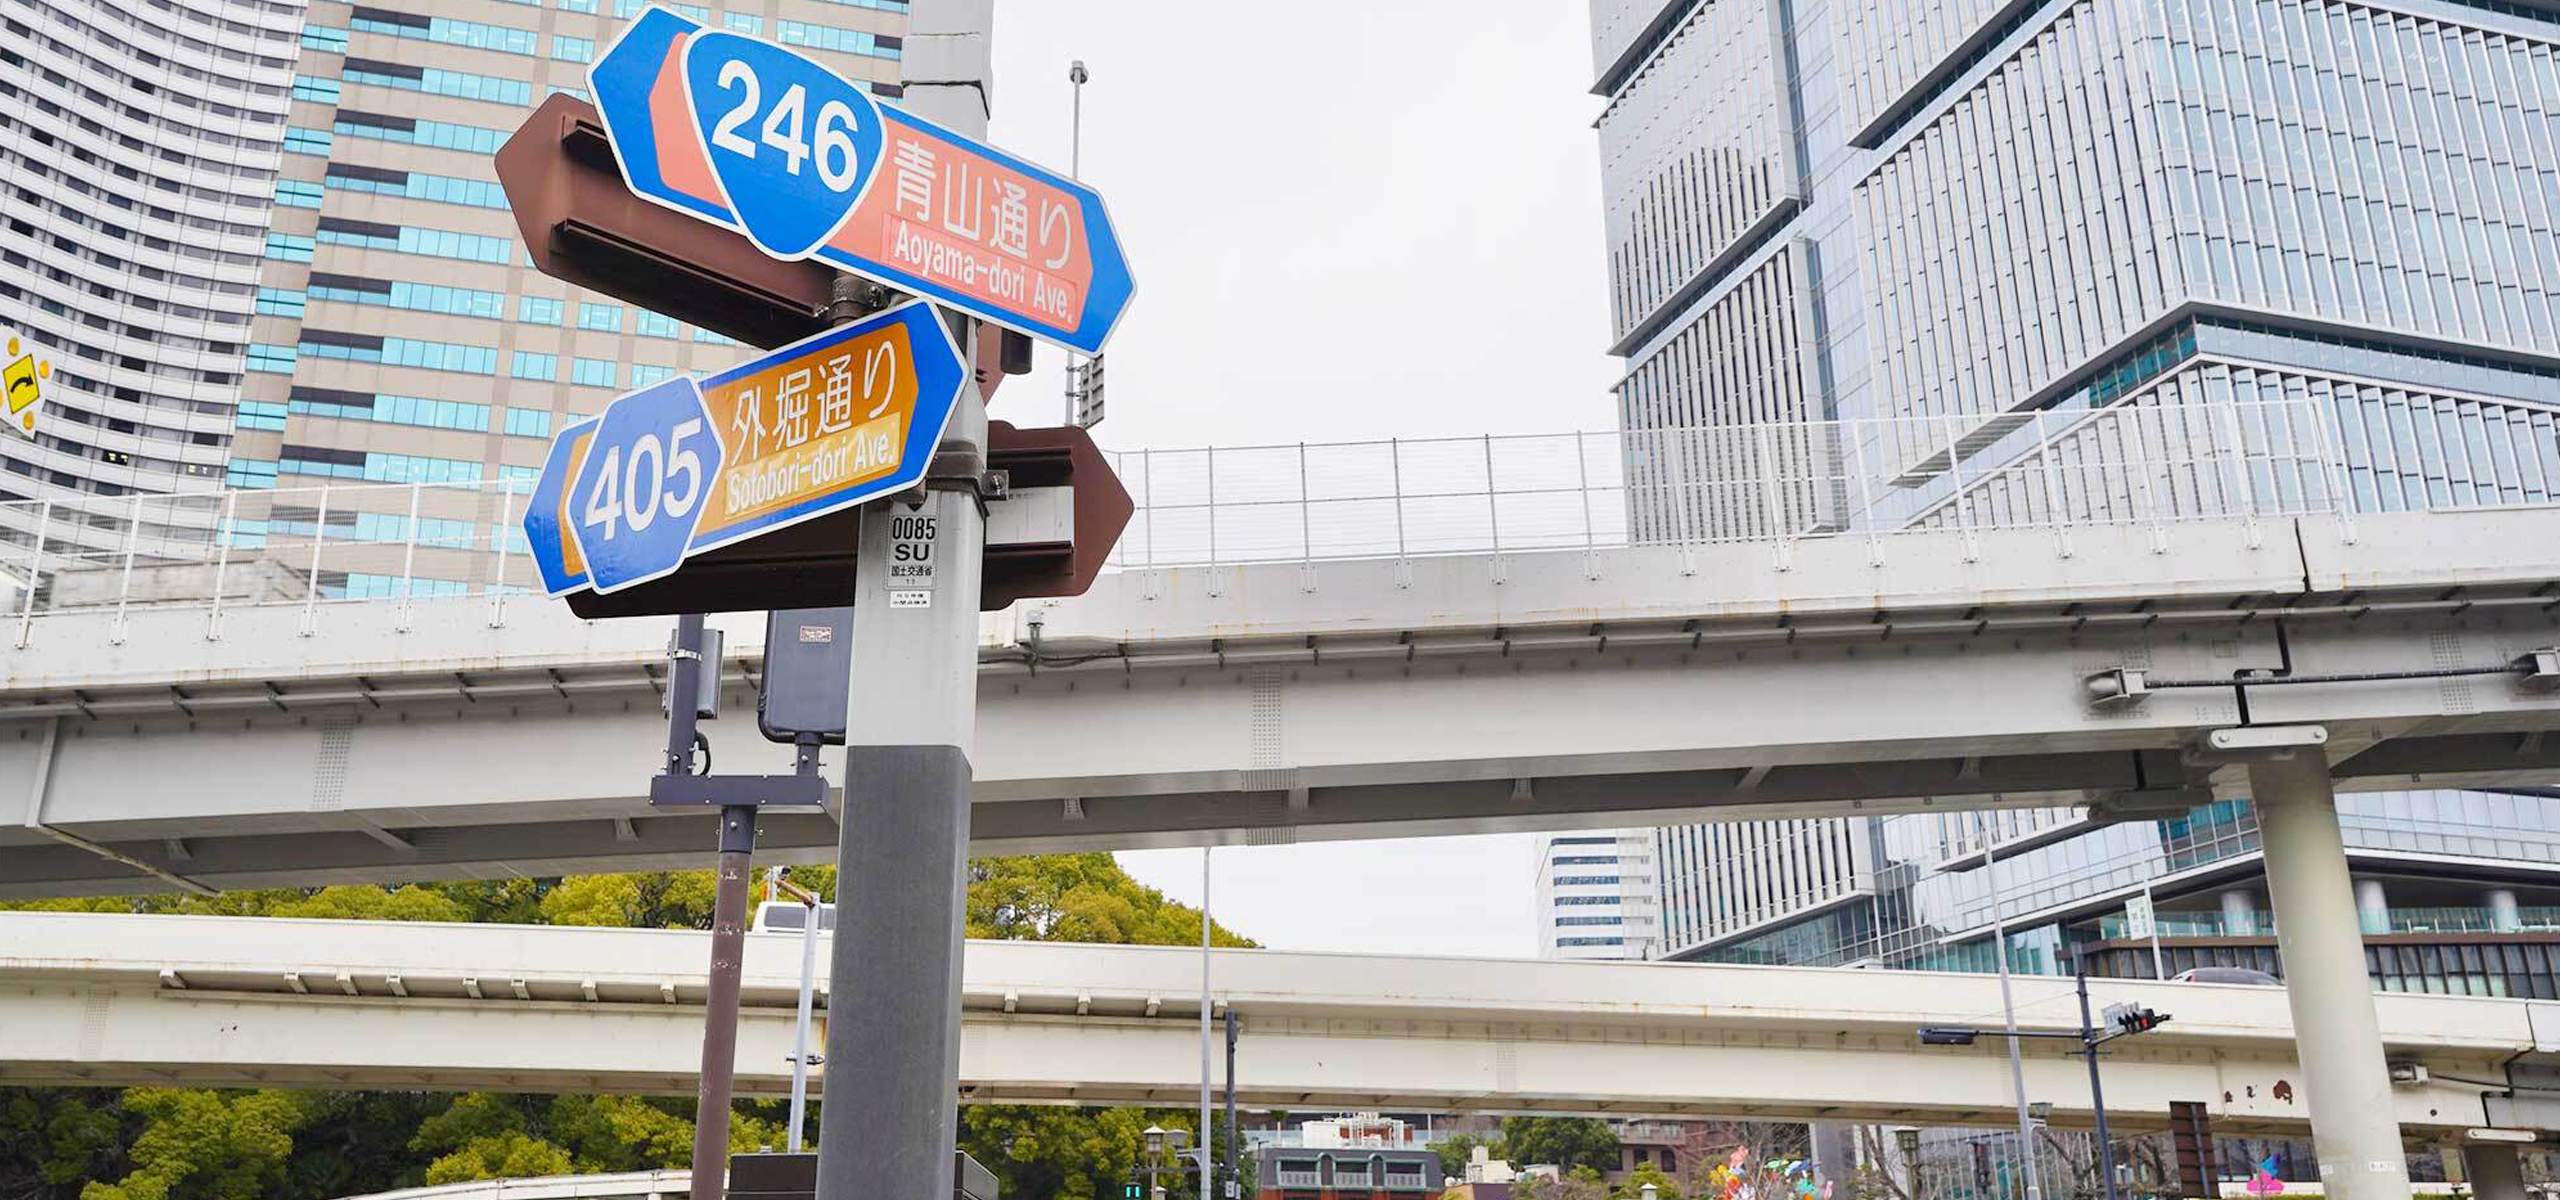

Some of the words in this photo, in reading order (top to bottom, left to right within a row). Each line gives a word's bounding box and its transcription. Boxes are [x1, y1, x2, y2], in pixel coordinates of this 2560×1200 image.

[711, 59, 859, 193] 246
[893, 138, 1072, 270] 青山通り
[894, 217, 1025, 301] Aoyama-dori
[1032, 272, 1074, 324] Ave.
[731, 340, 897, 467] 外堀通り
[584, 416, 702, 541] 405
[728, 437, 848, 514] Sotobori-dori
[854, 430, 896, 472] Ave.
[892, 517, 936, 540] 0085
[894, 543, 930, 561] SU
